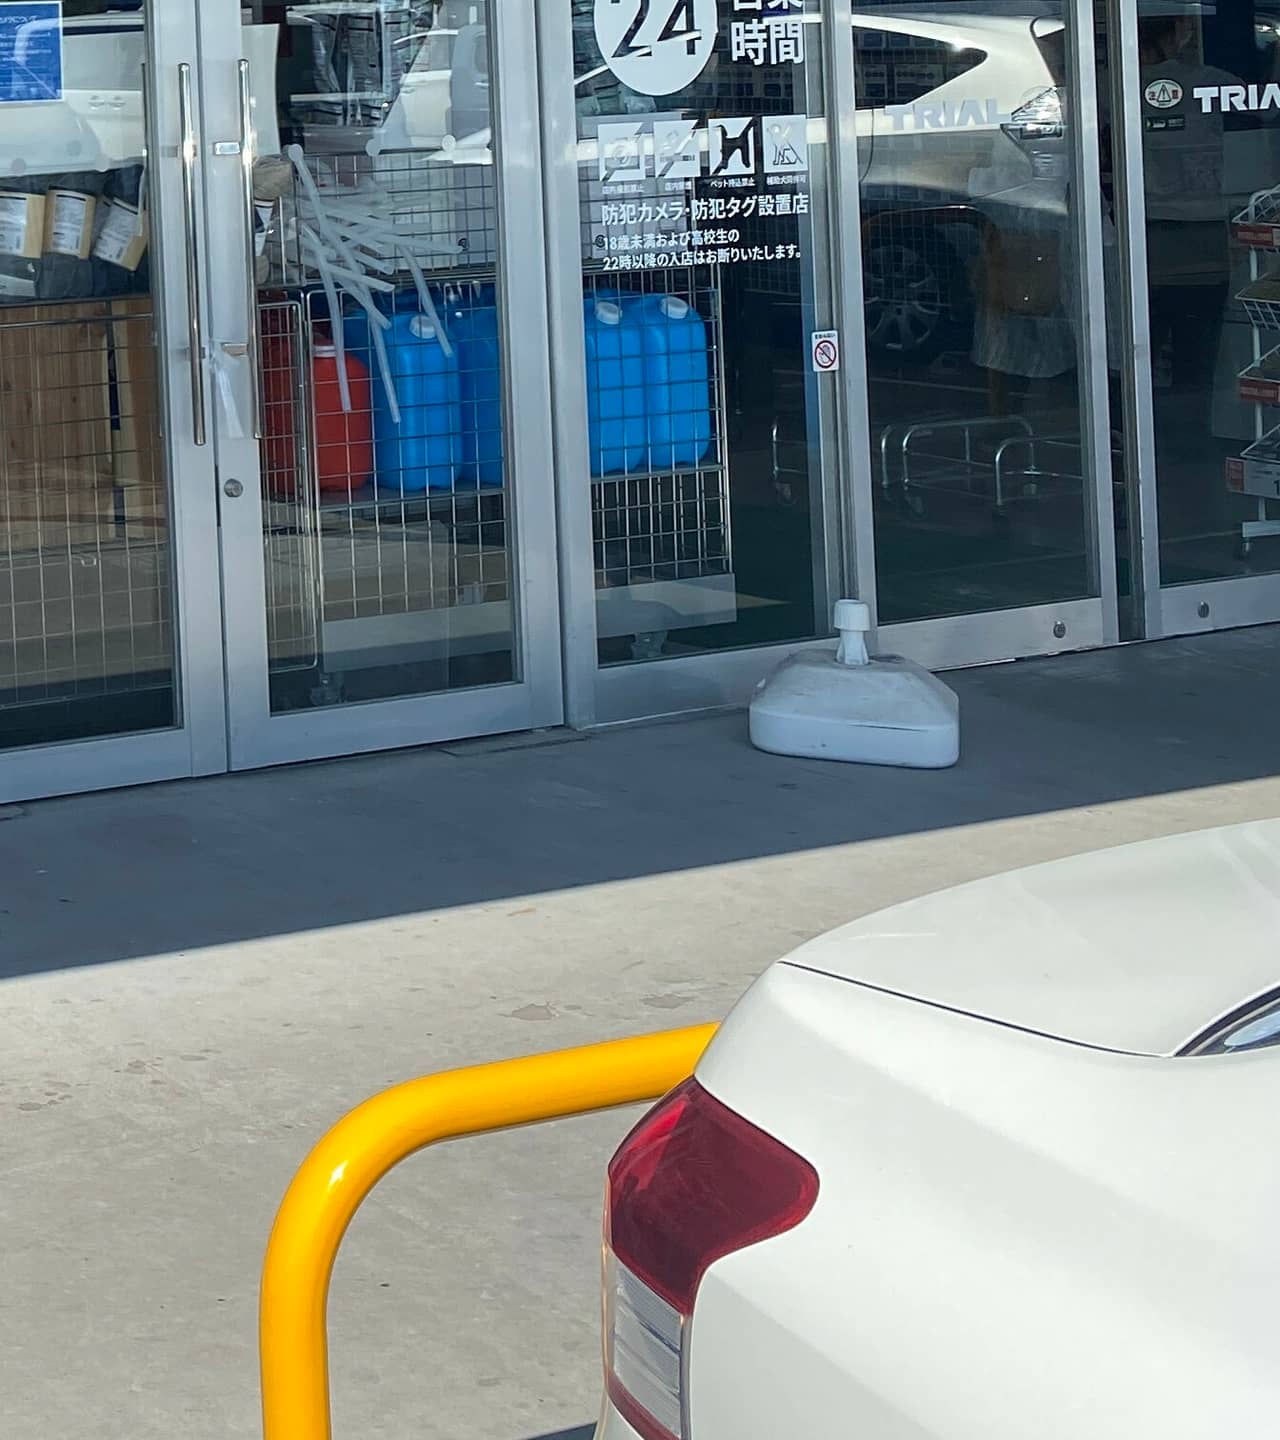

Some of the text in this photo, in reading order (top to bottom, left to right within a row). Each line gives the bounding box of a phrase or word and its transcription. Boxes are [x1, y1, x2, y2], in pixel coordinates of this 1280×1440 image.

[730, 17, 806, 66] 時間
[884, 98, 1012, 131] TRIAL
[601, 192, 810, 226] 防犯カメラ・防犯タグ設置店
[603, 228, 741, 251] 18歳未満および高校生の
[602, 243, 803, 272] 22時以降の入店はお断りいたします。
